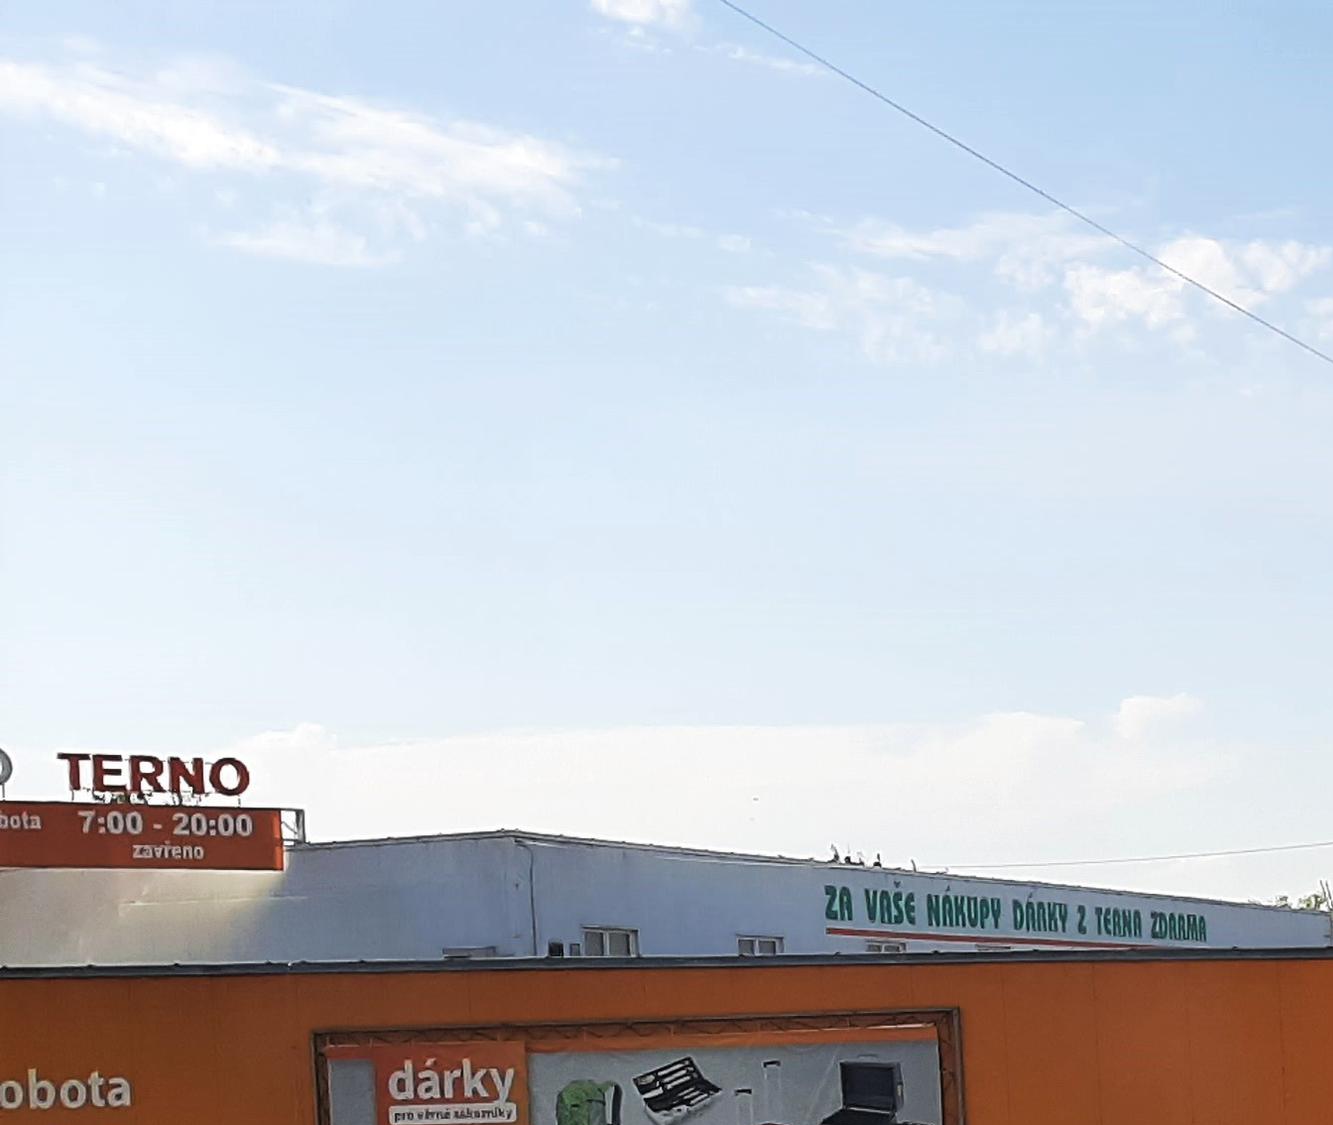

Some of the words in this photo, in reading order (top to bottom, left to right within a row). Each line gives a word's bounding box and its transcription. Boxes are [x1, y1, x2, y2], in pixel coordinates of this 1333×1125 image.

[57, 752, 250, 796] TERNO
[78, 811, 143, 834] 7:00
[172, 812, 253, 836] 20:00
[133, 840, 204, 860] zavřeno
[824, 885, 853, 921] ZA
[864, 880, 916, 925] VAŠE
[927, 885, 1001, 929] NÁKUPY
[1012, 890, 1068, 933] DÁRKY
[1077, 905, 1087, 935] Z
[1095, 907, 1143, 938] TERNA
[1151, 911, 1207, 942] ZDARMA
[388, 1057, 515, 1104] dárky
[394, 1112, 414, 1123] pro
